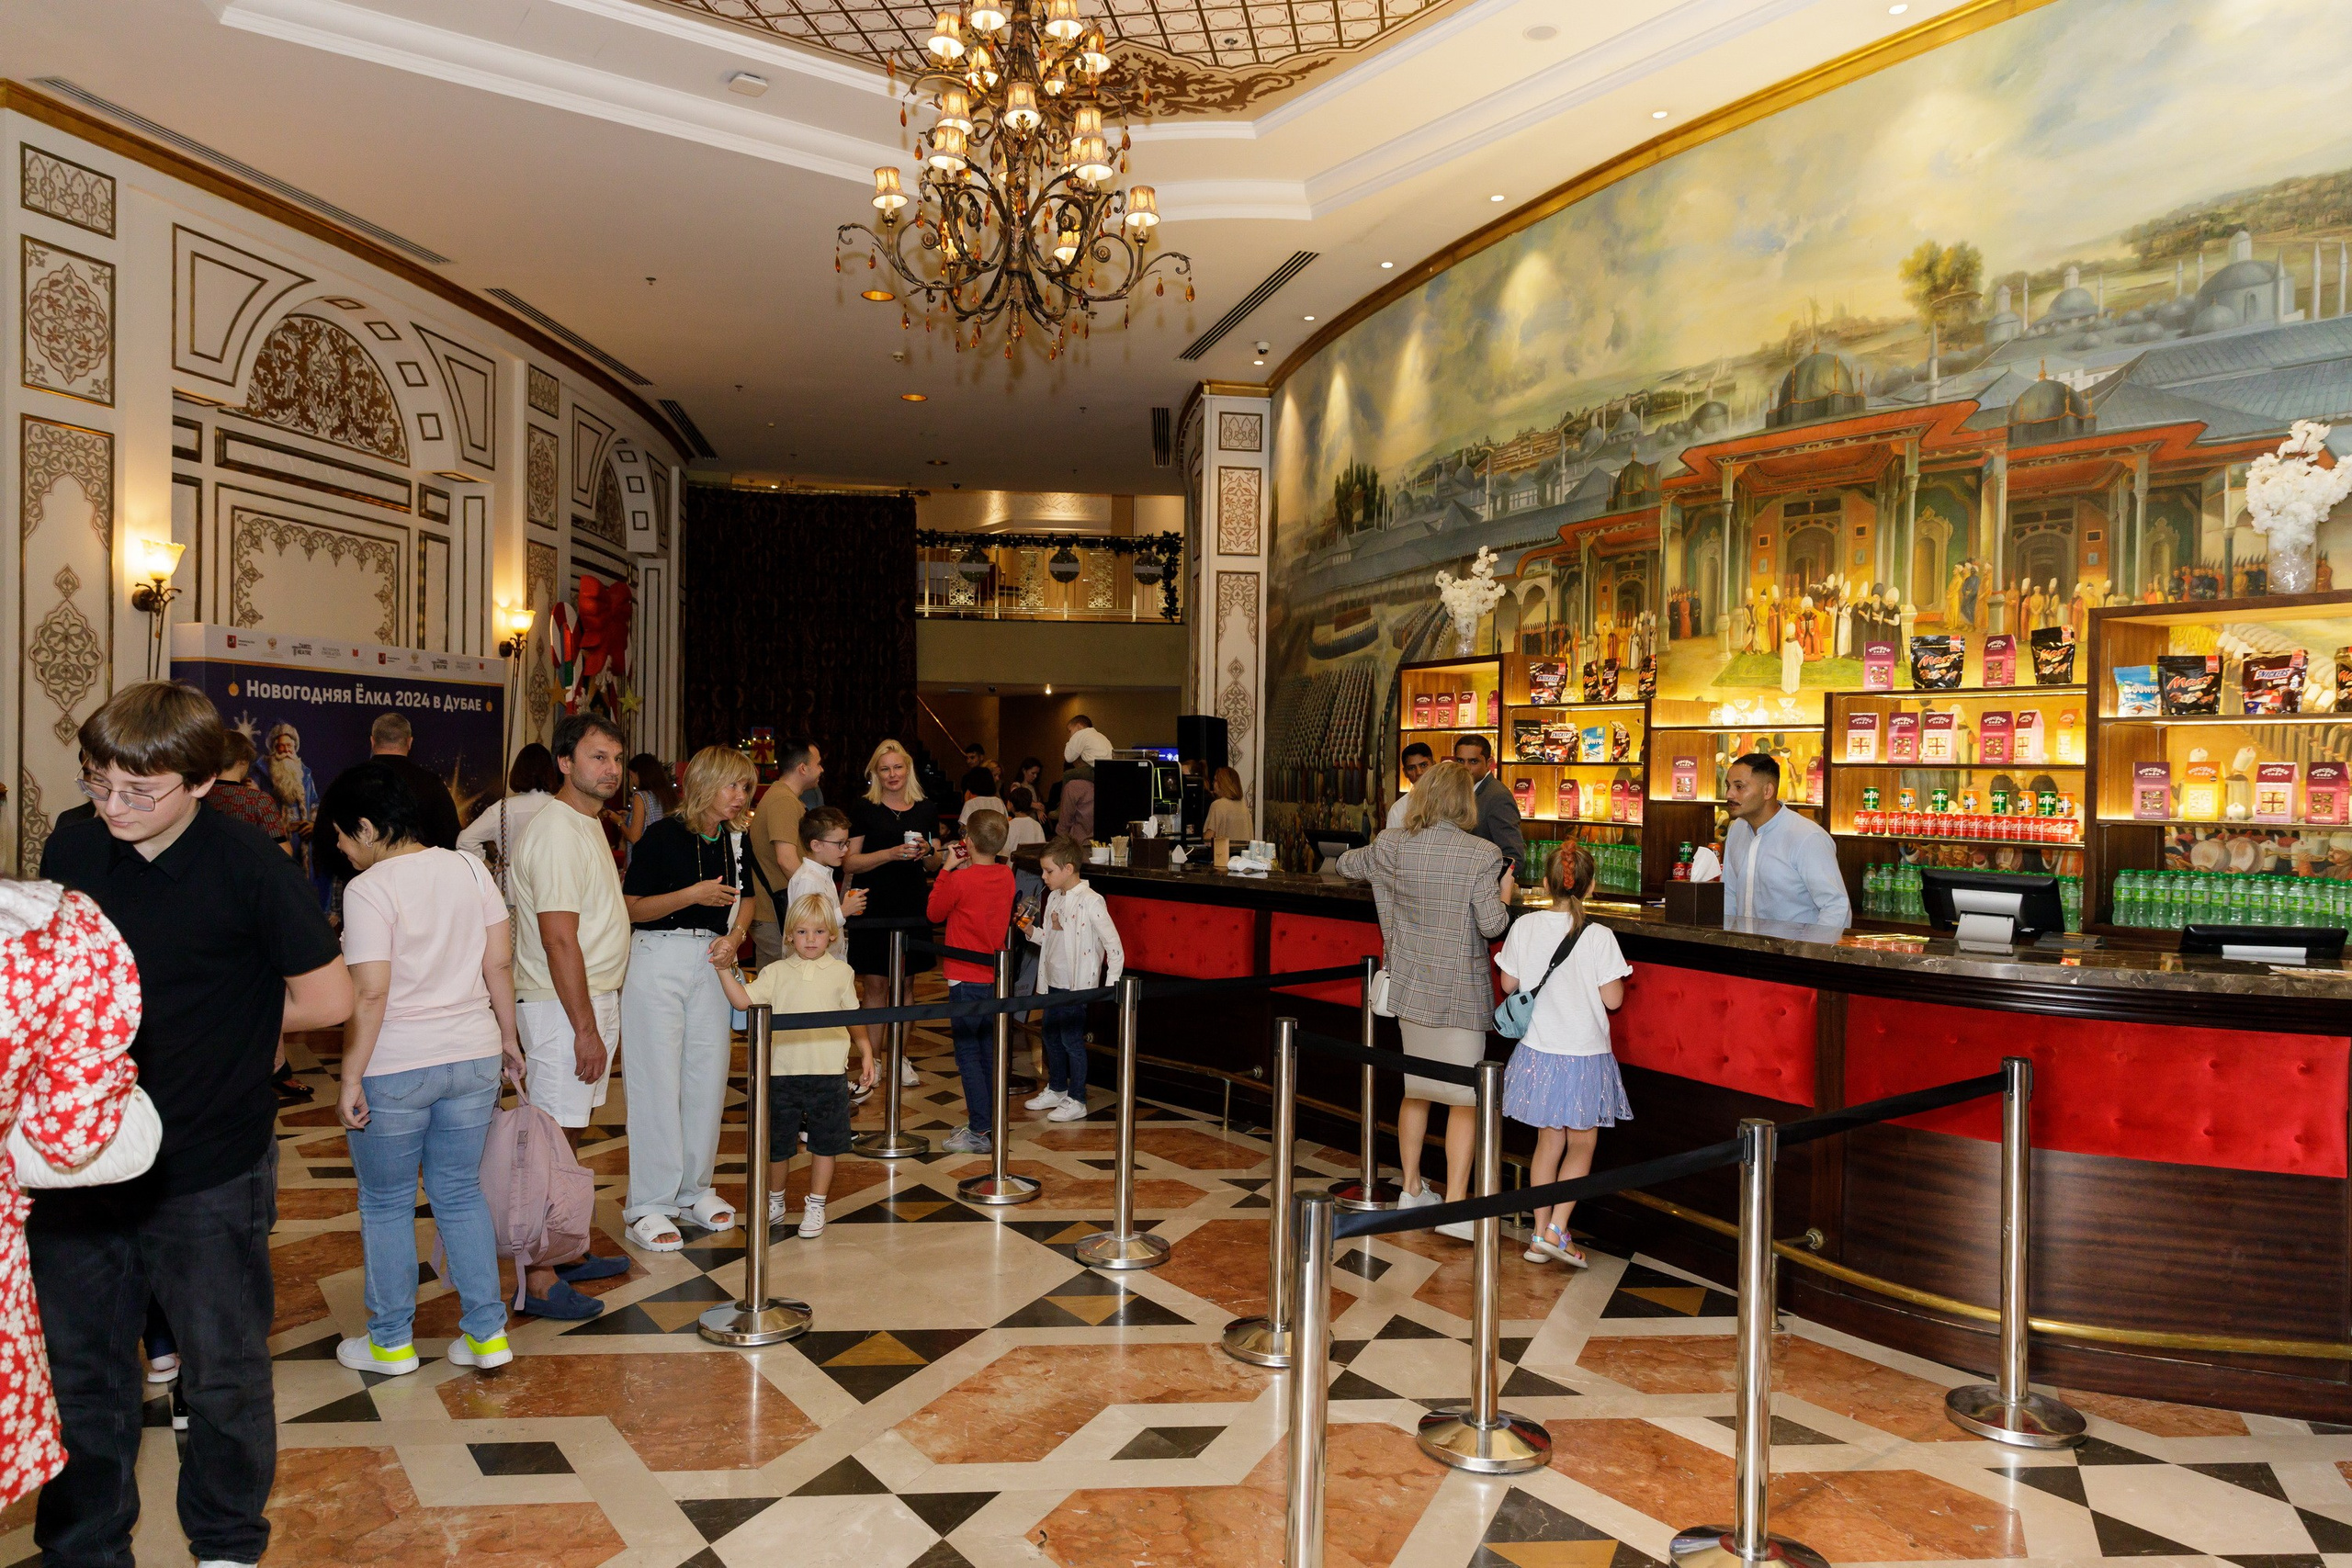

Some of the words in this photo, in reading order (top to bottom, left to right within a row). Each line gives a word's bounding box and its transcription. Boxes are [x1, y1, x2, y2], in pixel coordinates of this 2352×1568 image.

[1917, 654, 1956, 668] Mars
[2037, 646, 2070, 662] Mars
[2256, 670, 2290, 678] SNICKERS
[2166, 675, 2214, 690] Mars
[395, 691, 430, 708] 2024
